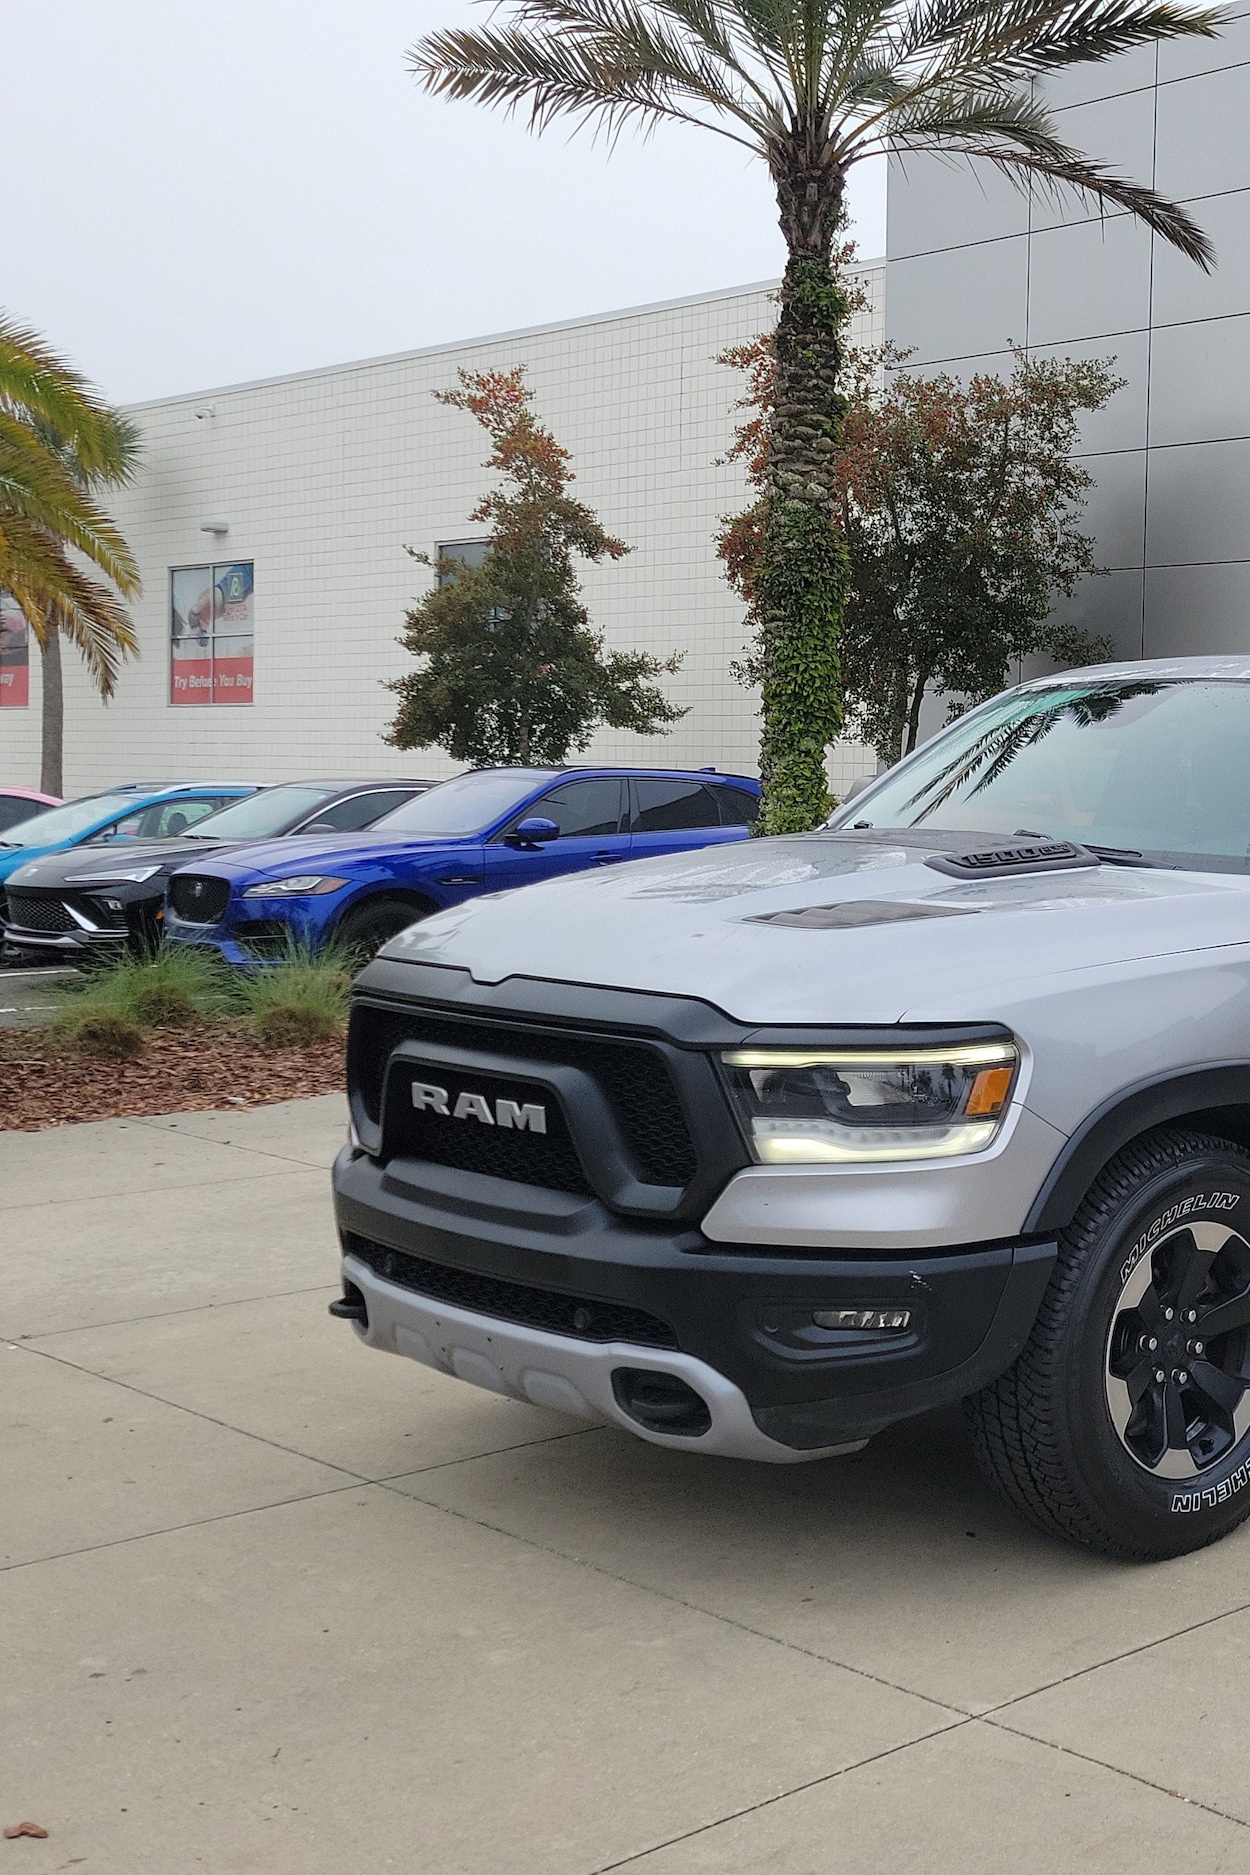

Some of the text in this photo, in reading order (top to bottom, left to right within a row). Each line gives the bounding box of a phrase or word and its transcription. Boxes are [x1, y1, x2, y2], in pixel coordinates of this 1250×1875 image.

[174, 673, 253, 690] Try Before You Buy
[961, 847, 1040, 865] 1500
[411, 1081, 547, 1134] RAM
[1120, 1192, 1240, 1285] MICHELIN
